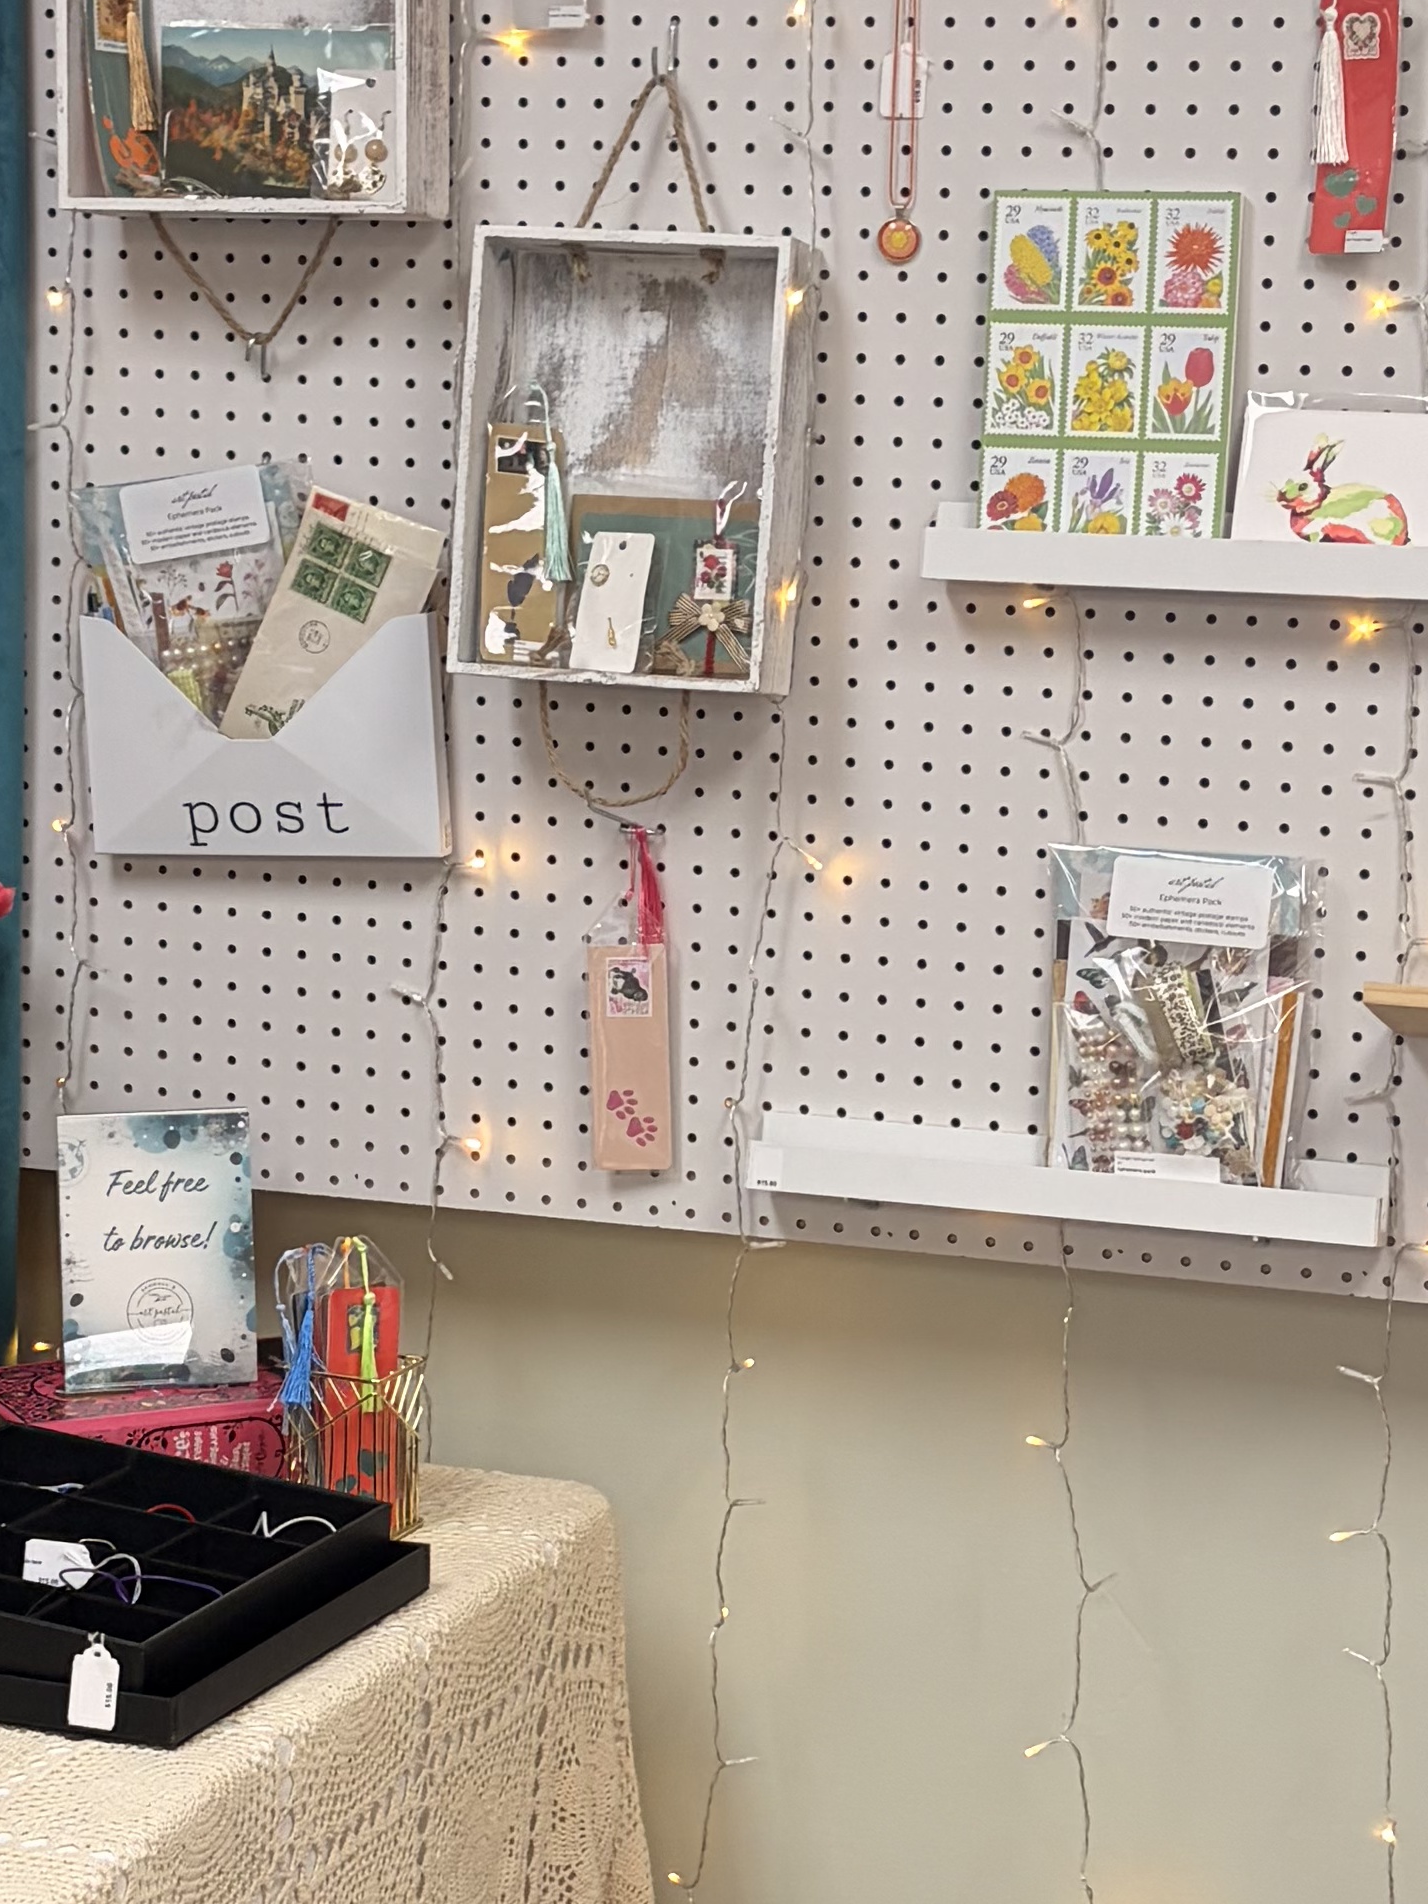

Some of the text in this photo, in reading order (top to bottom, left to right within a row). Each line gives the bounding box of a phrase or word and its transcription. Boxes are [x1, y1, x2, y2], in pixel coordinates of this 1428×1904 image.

[1005, 205, 1021, 218] 29
[1085, 207, 1100, 218] 32
[1165, 208, 1180, 220] 32
[999, 332, 1015, 345] 29
[1078, 333, 1093, 345] 32
[1159, 333, 1176, 346] 29
[990, 455, 1007, 468] 29
[1072, 457, 1089, 469] 29
[1153, 461, 1167, 472] 32
[182, 792, 350, 847] post
[106, 1169, 209, 1202] Feel free
[103, 1221, 218, 1252] to browse!
